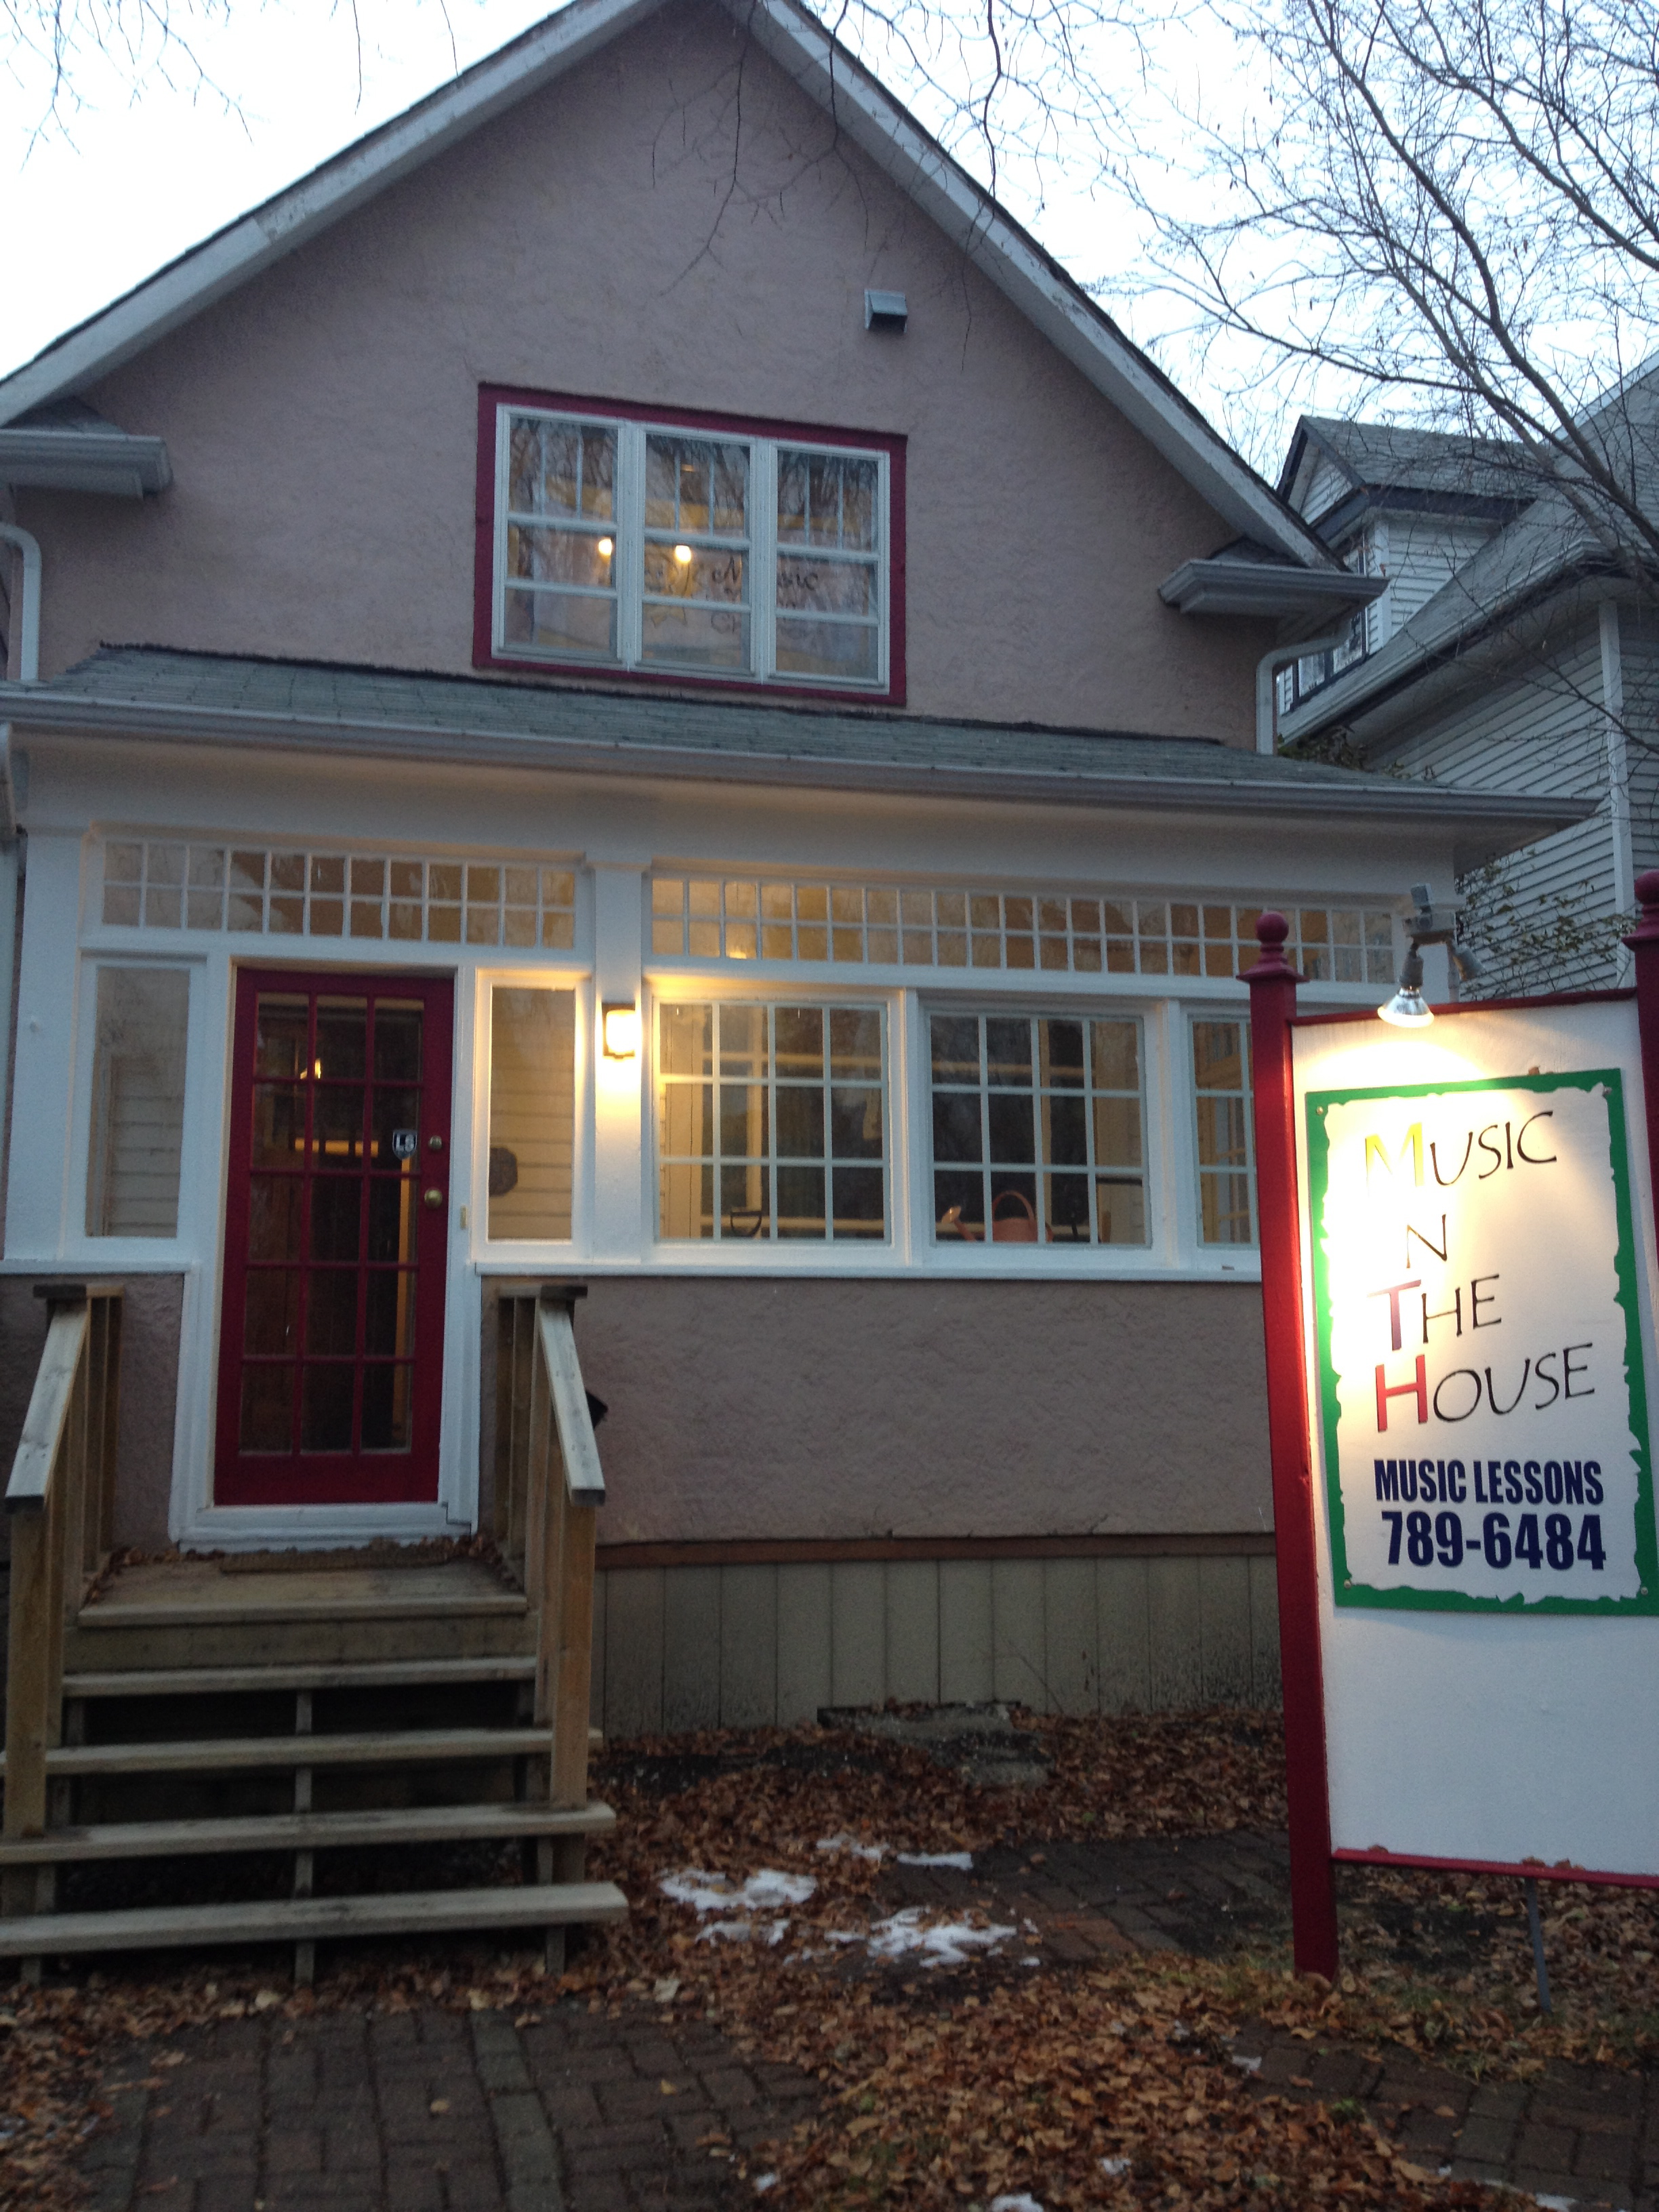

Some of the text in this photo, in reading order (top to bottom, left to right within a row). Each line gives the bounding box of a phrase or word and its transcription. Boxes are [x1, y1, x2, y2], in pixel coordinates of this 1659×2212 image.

[1365, 1111, 1558, 1195] MUSIC
[1368, 1274, 1502, 1351] THE
[1376, 1343, 1595, 1433] HOUSE
[1374, 1459, 1604, 1504] MUSIC LESSONS
[1381, 1511, 1606, 1571] 789-6484
